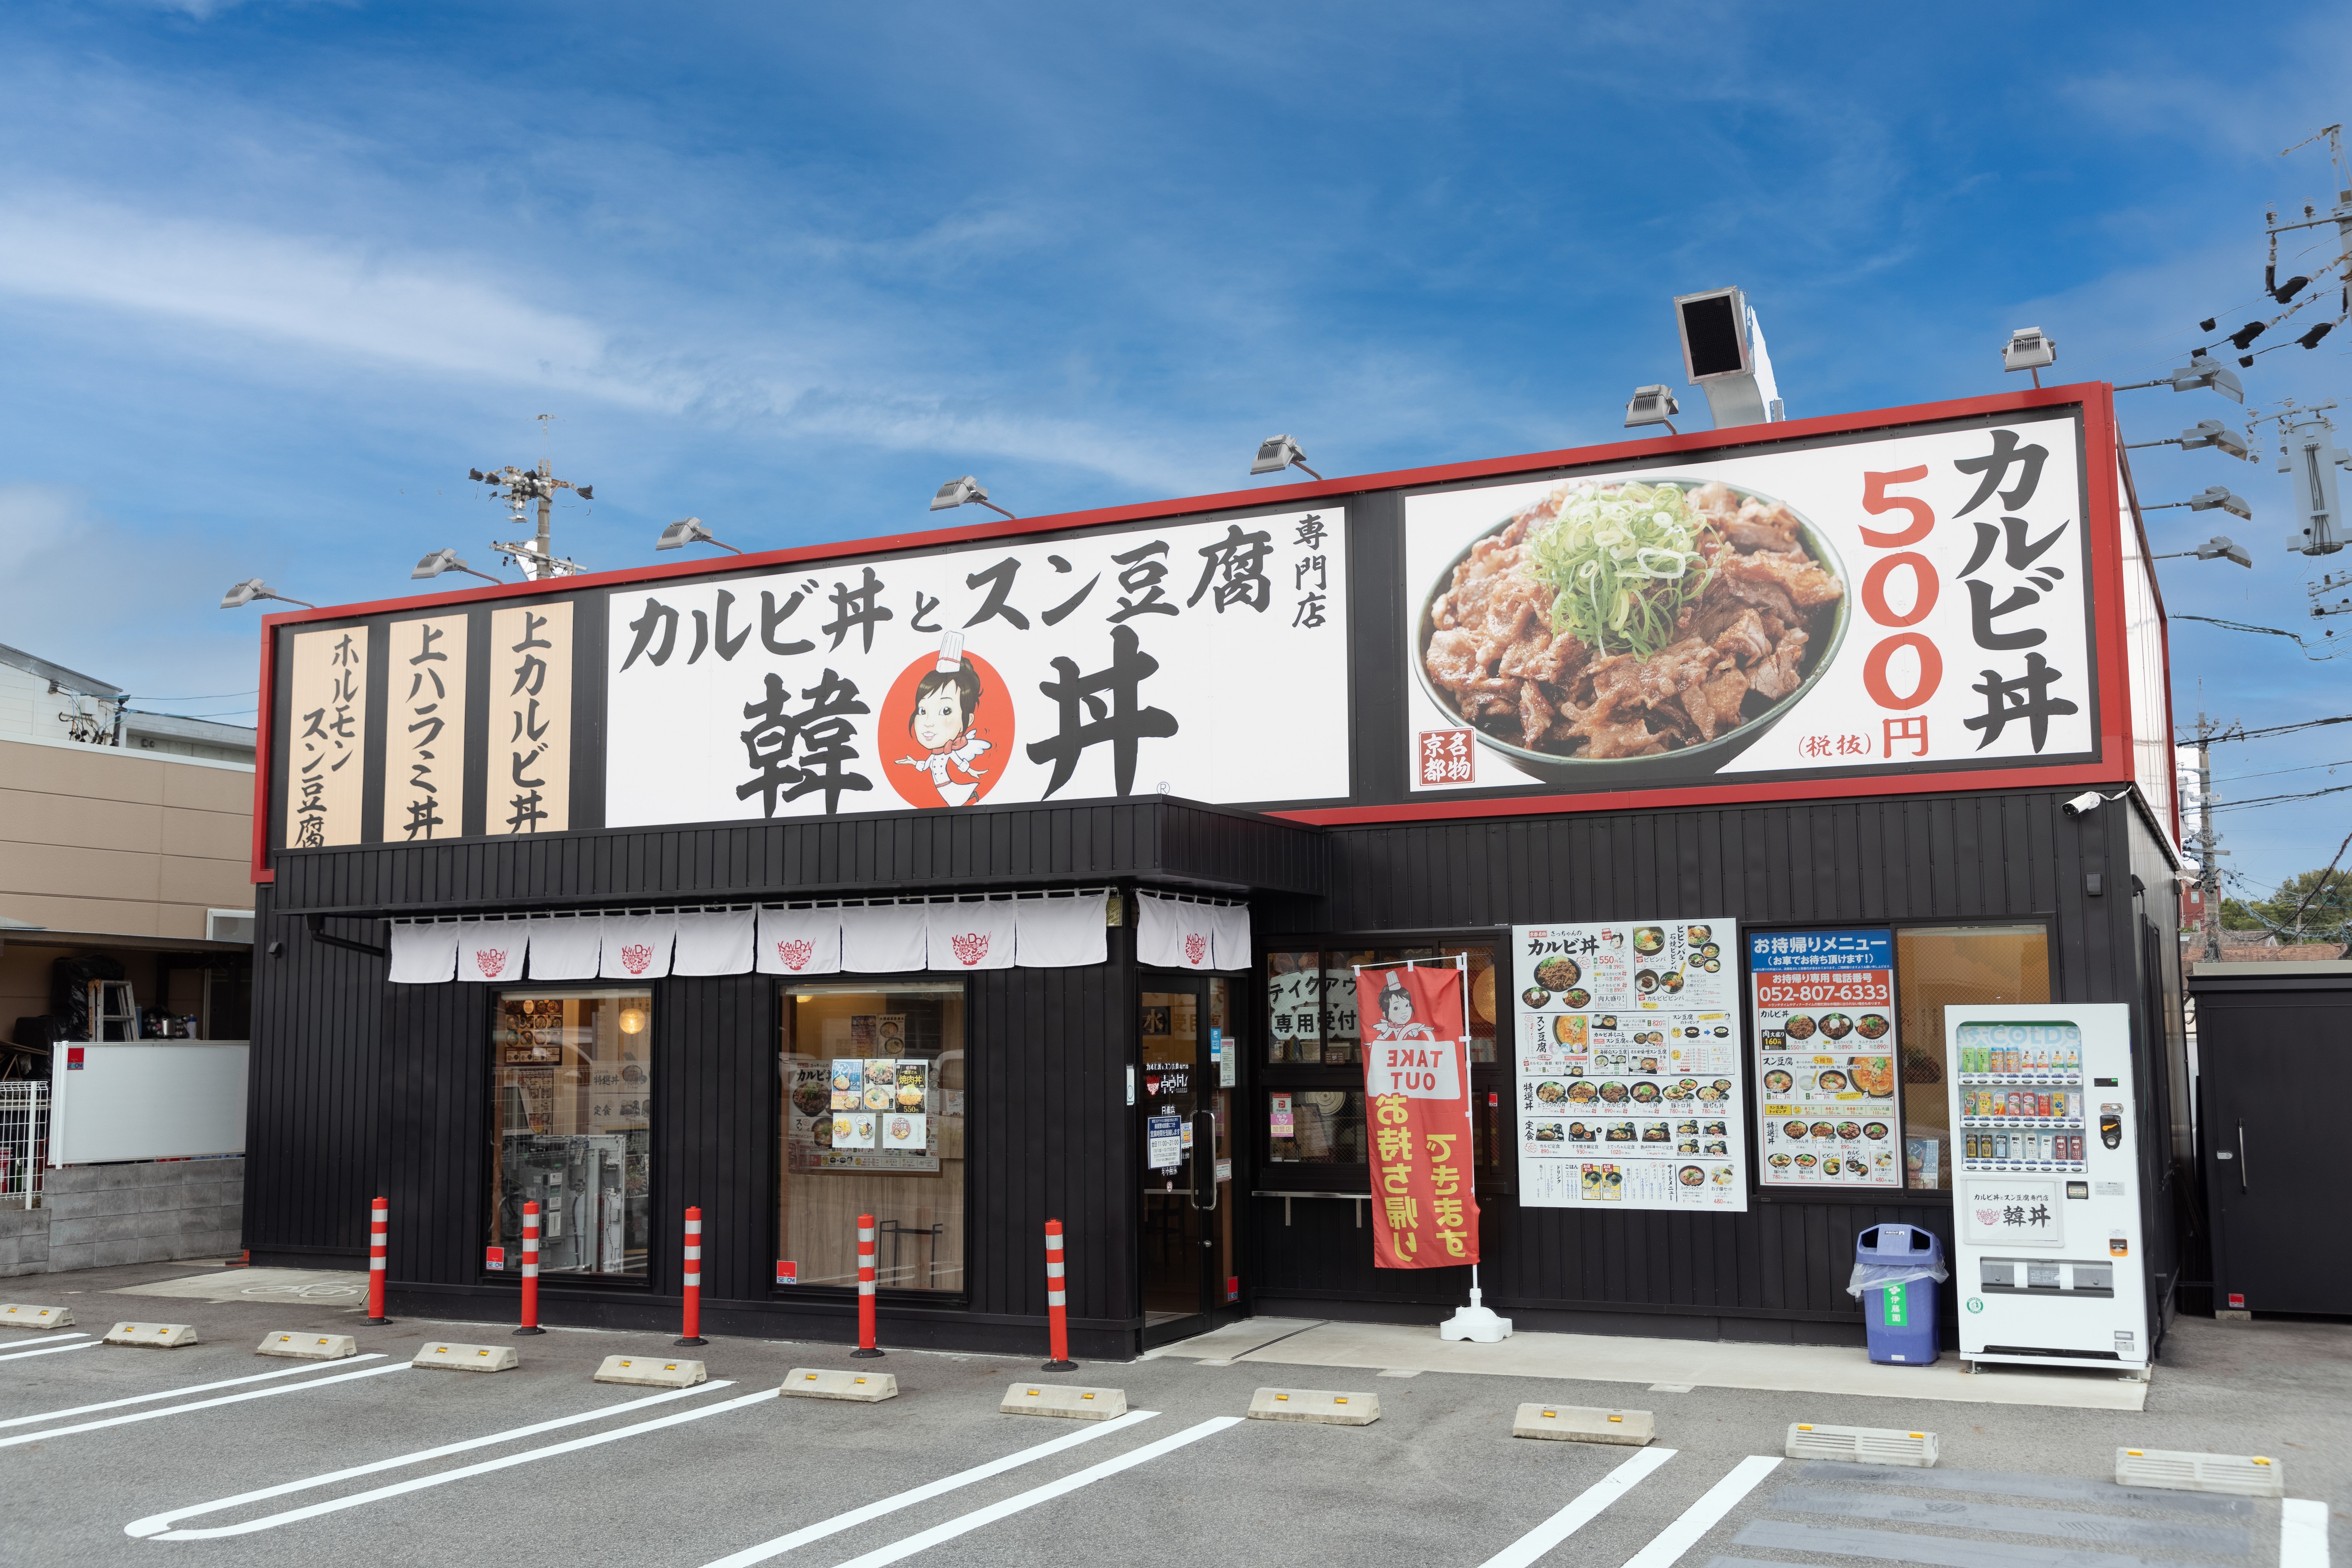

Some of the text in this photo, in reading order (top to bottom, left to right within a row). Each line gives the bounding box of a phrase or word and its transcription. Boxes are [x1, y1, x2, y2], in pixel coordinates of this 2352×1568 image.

[1293, 514, 1328, 628] 専門店
[620, 525, 1273, 673] カルビ丼とスン豆腐
[1952, 429, 2079, 752] カルビ丼
[1858, 465, 1942, 758] 500円
[329, 634, 359, 771] ホルモン
[404, 625, 447, 841] 上ハラミ丼
[510, 612, 552, 833] 上カルビ丼
[737, 626, 1178, 818] 韓 丼
[1423, 733, 1446, 782] 京都
[1446, 732, 1470, 780] 名物
[1799, 733, 1871, 758] (税抜)
[294, 708, 328, 847] スン豆腐
[1528, 935, 1600, 957] カルビ丼
[1754, 937, 1887, 954] お持帰りメニュー
[1768, 954, 1873, 966] (お車でお待ち頂けます!)
[1772, 973, 1872, 983] お持帰り専用 電話番号
[1759, 985, 1887, 1002] 052-807-6333
[1536, 1016, 1547, 1053] スン豆腐
[1763, 1057, 1793, 1066] スン豆腐
[899, 1076, 922, 1084] 焼肉丼
[1523, 1082, 1534, 1111] 特選丼
[594, 1105, 611, 1116] 定食
[1150, 1129, 1180, 1138] 営業時間を短縮します
[1525, 1120, 1534, 1141] 定食
[2003, 1204, 2051, 1228] 韓丼
[1891, 1296, 1900, 1322] 伊藤園
